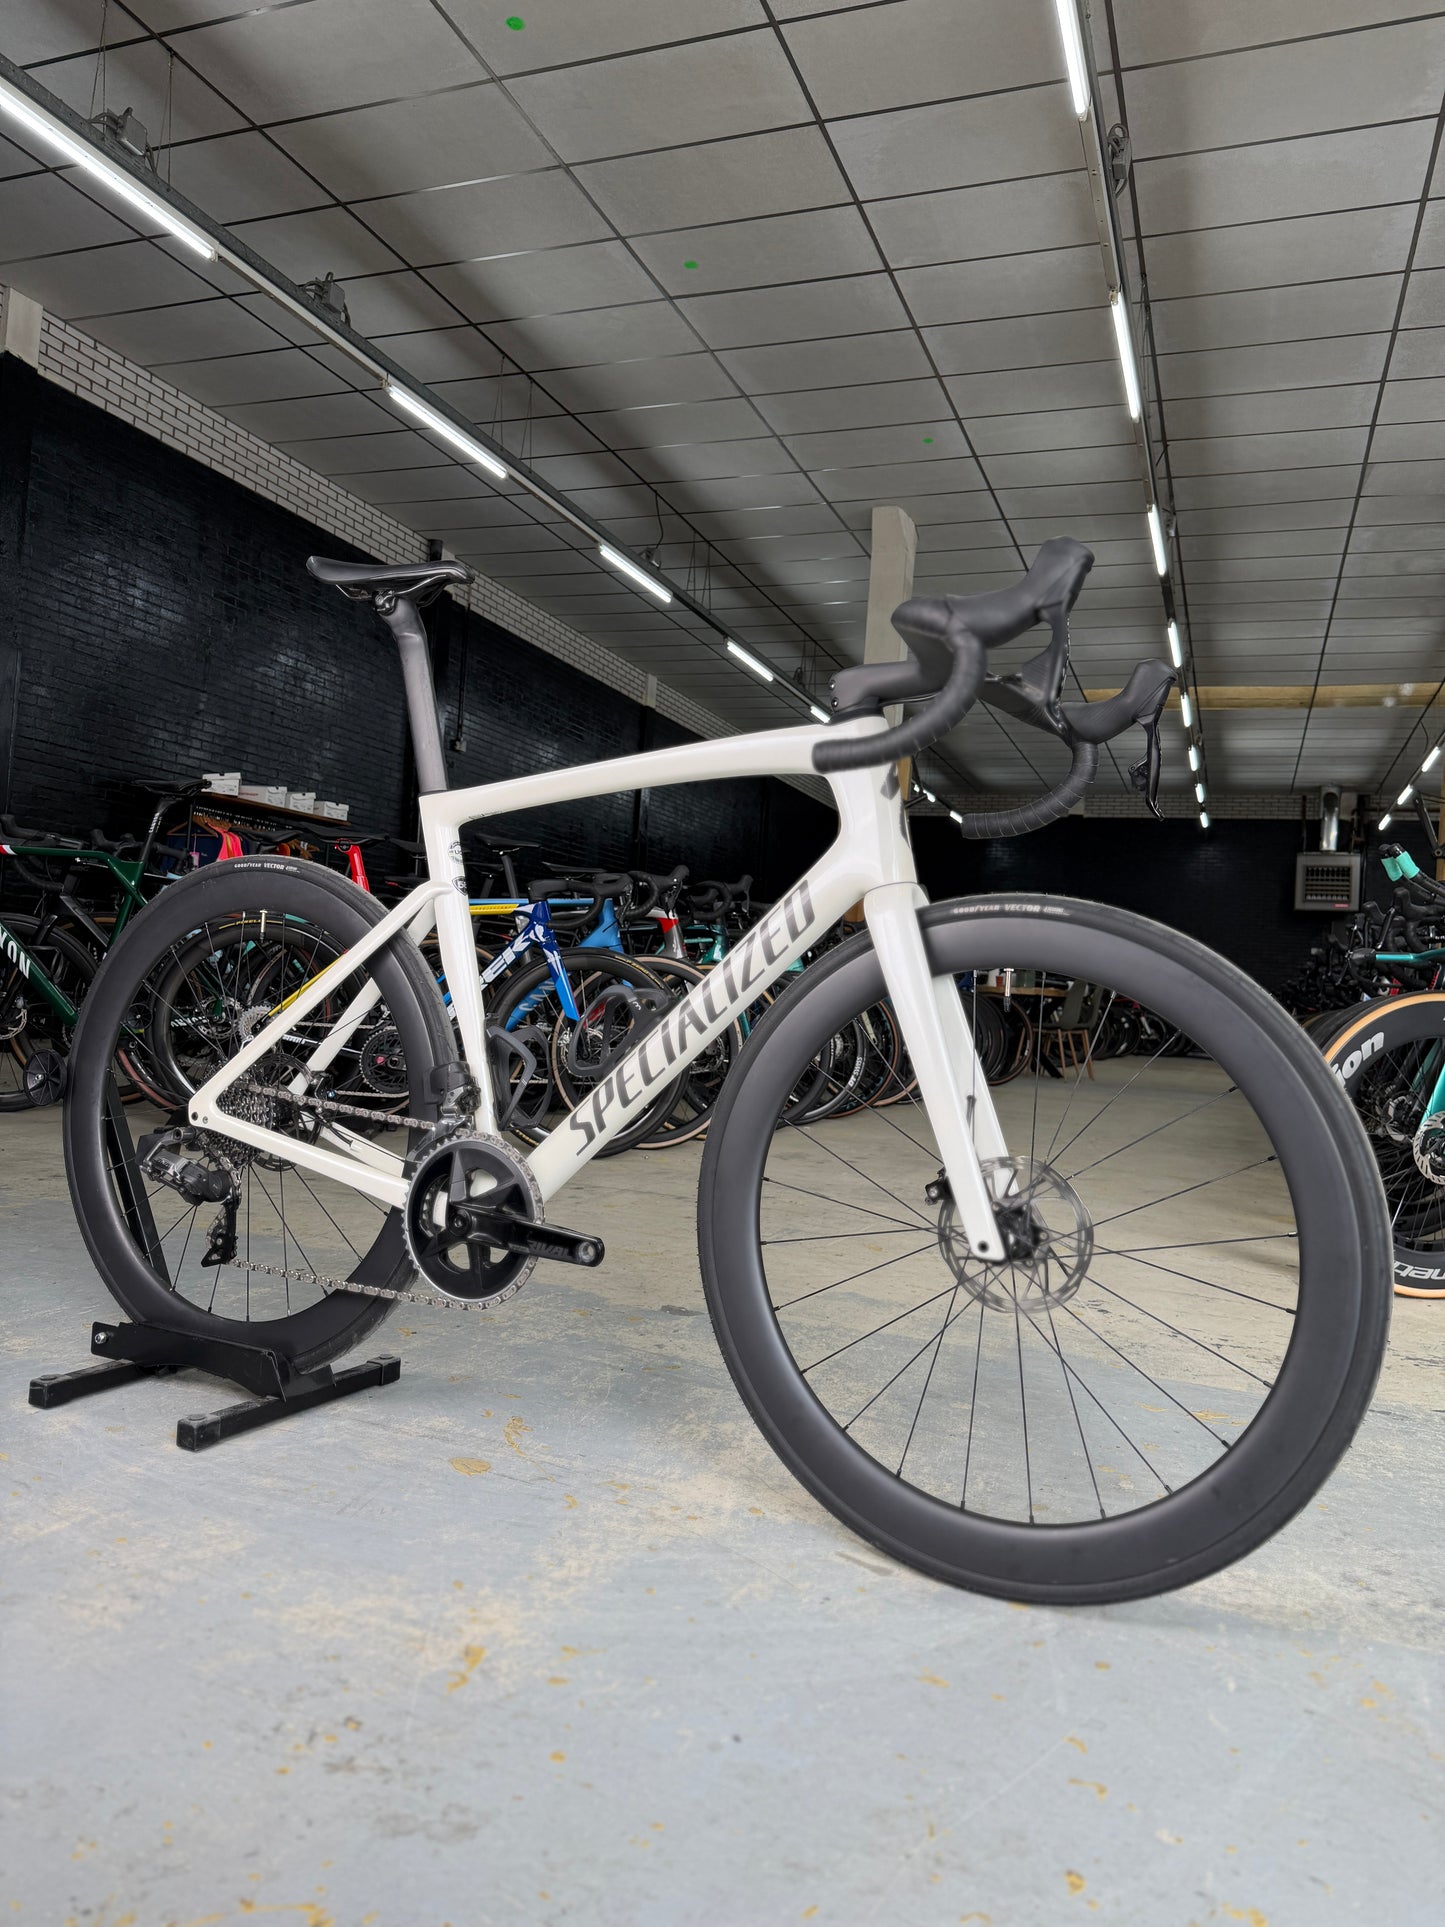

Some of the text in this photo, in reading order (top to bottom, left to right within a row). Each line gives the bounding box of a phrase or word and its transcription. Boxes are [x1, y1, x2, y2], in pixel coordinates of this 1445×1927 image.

[1004, 904, 1041, 912] VECTOR
[569, 879, 816, 1157] SPECIALIZED
[853, 1056, 862, 1076] SWISS
